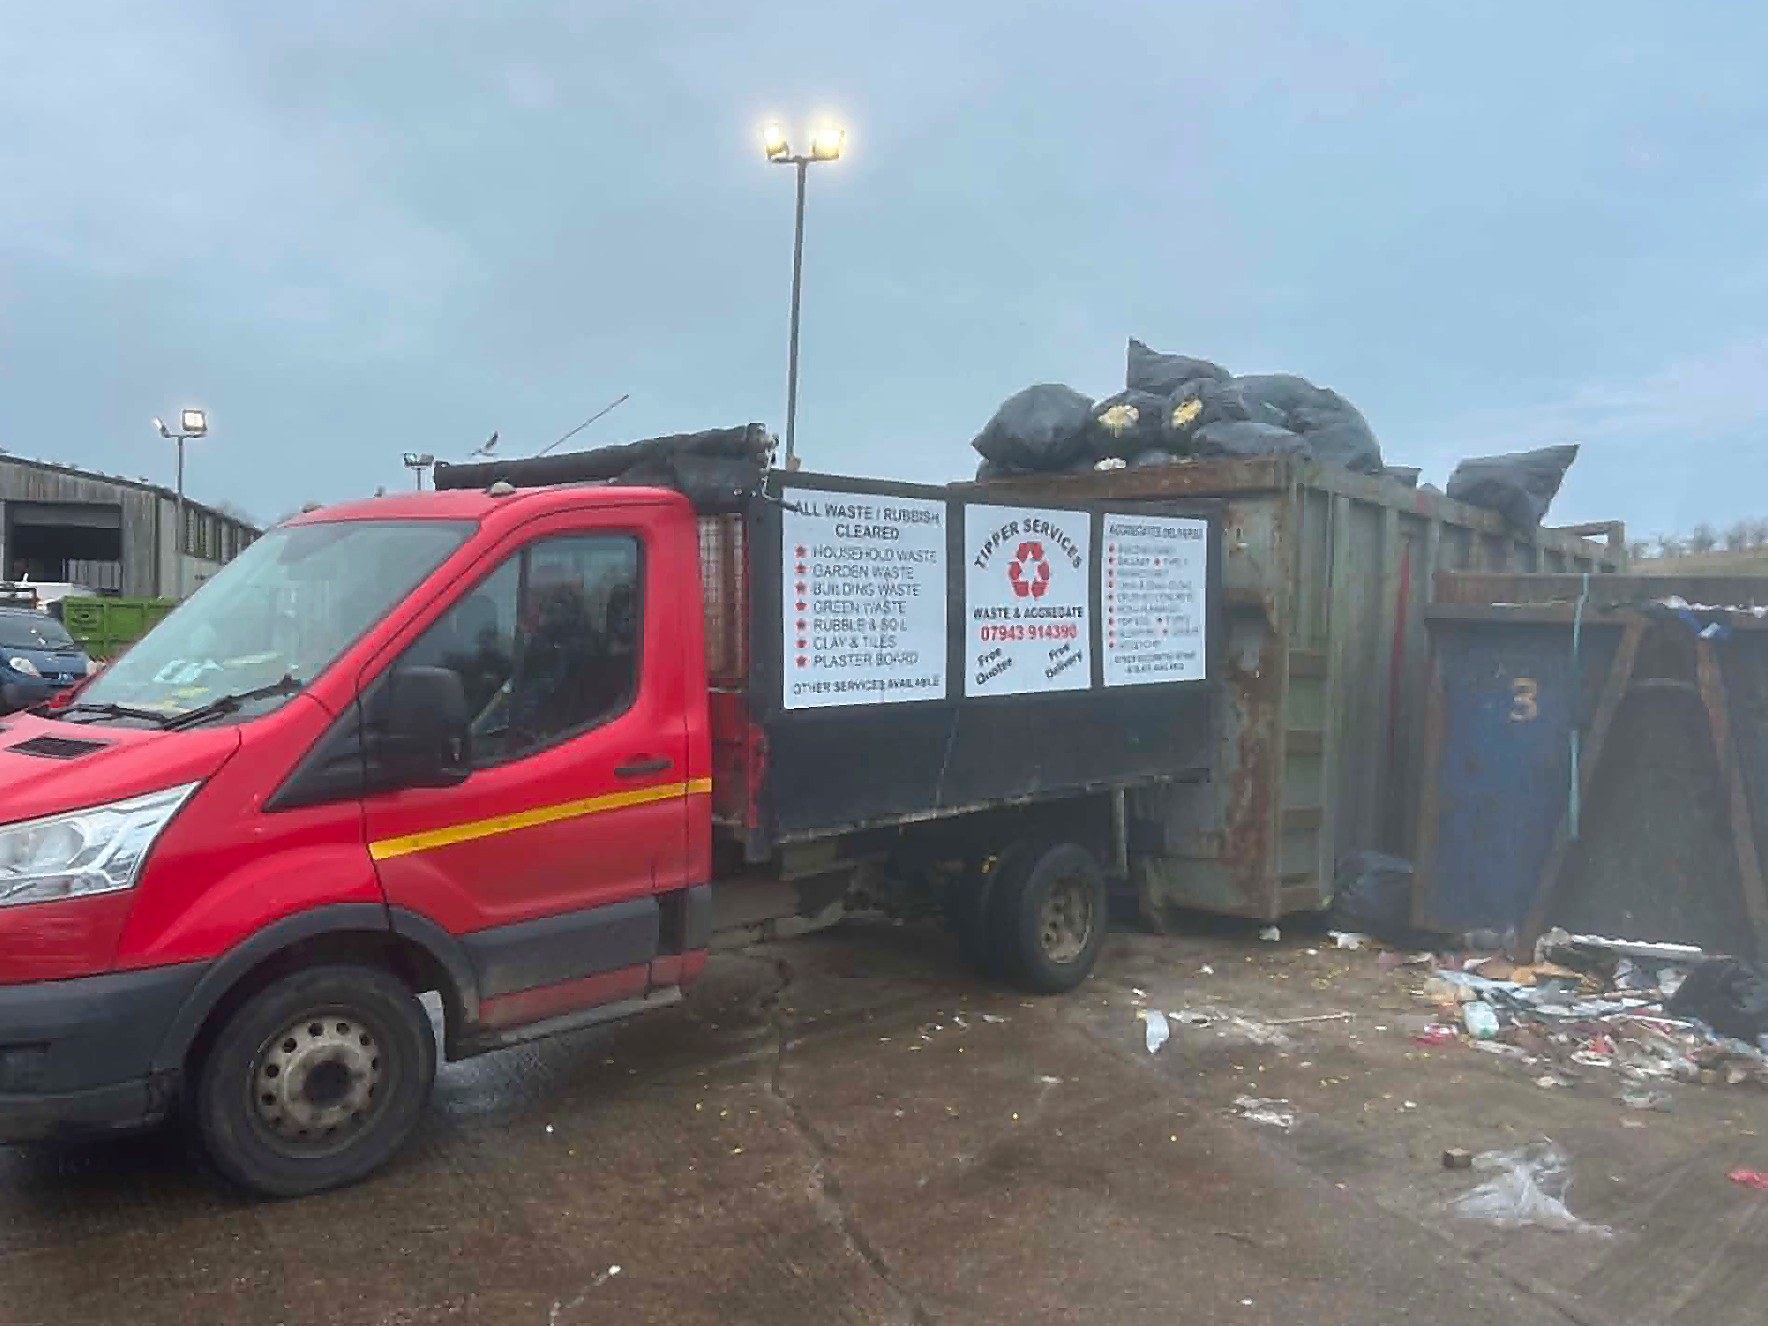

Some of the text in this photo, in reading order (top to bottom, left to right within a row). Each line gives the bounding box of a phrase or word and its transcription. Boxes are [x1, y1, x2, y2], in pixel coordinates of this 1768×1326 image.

[795, 501, 821, 516] ALL
[825, 503, 872, 520] WASTE
[883, 508, 940, 524] RUBBISH
[835, 523, 900, 540] CLEARED
[974, 518, 1082, 569] TIPPER SERVICES
[813, 545, 937, 563] HOUSEHOLD WASTE
[813, 563, 914, 580] GARDEN WASTE
[813, 582, 921, 597] BUILDING WASTE
[813, 600, 907, 615] GREEN WASTE
[973, 606, 1010, 619] WASTE
[1013, 607, 1021, 618] &
[813, 617, 907, 632] RUBBLE & SOIL
[981, 624, 1077, 641] 07943 914390
[813, 635, 898, 650] CLAY & TILES
[813, 651, 919, 668] PLASTER BOARD
[793, 676, 940, 695] OTHER SERVICES AVAILABLE
[1510, 677, 1537, 721] 3
